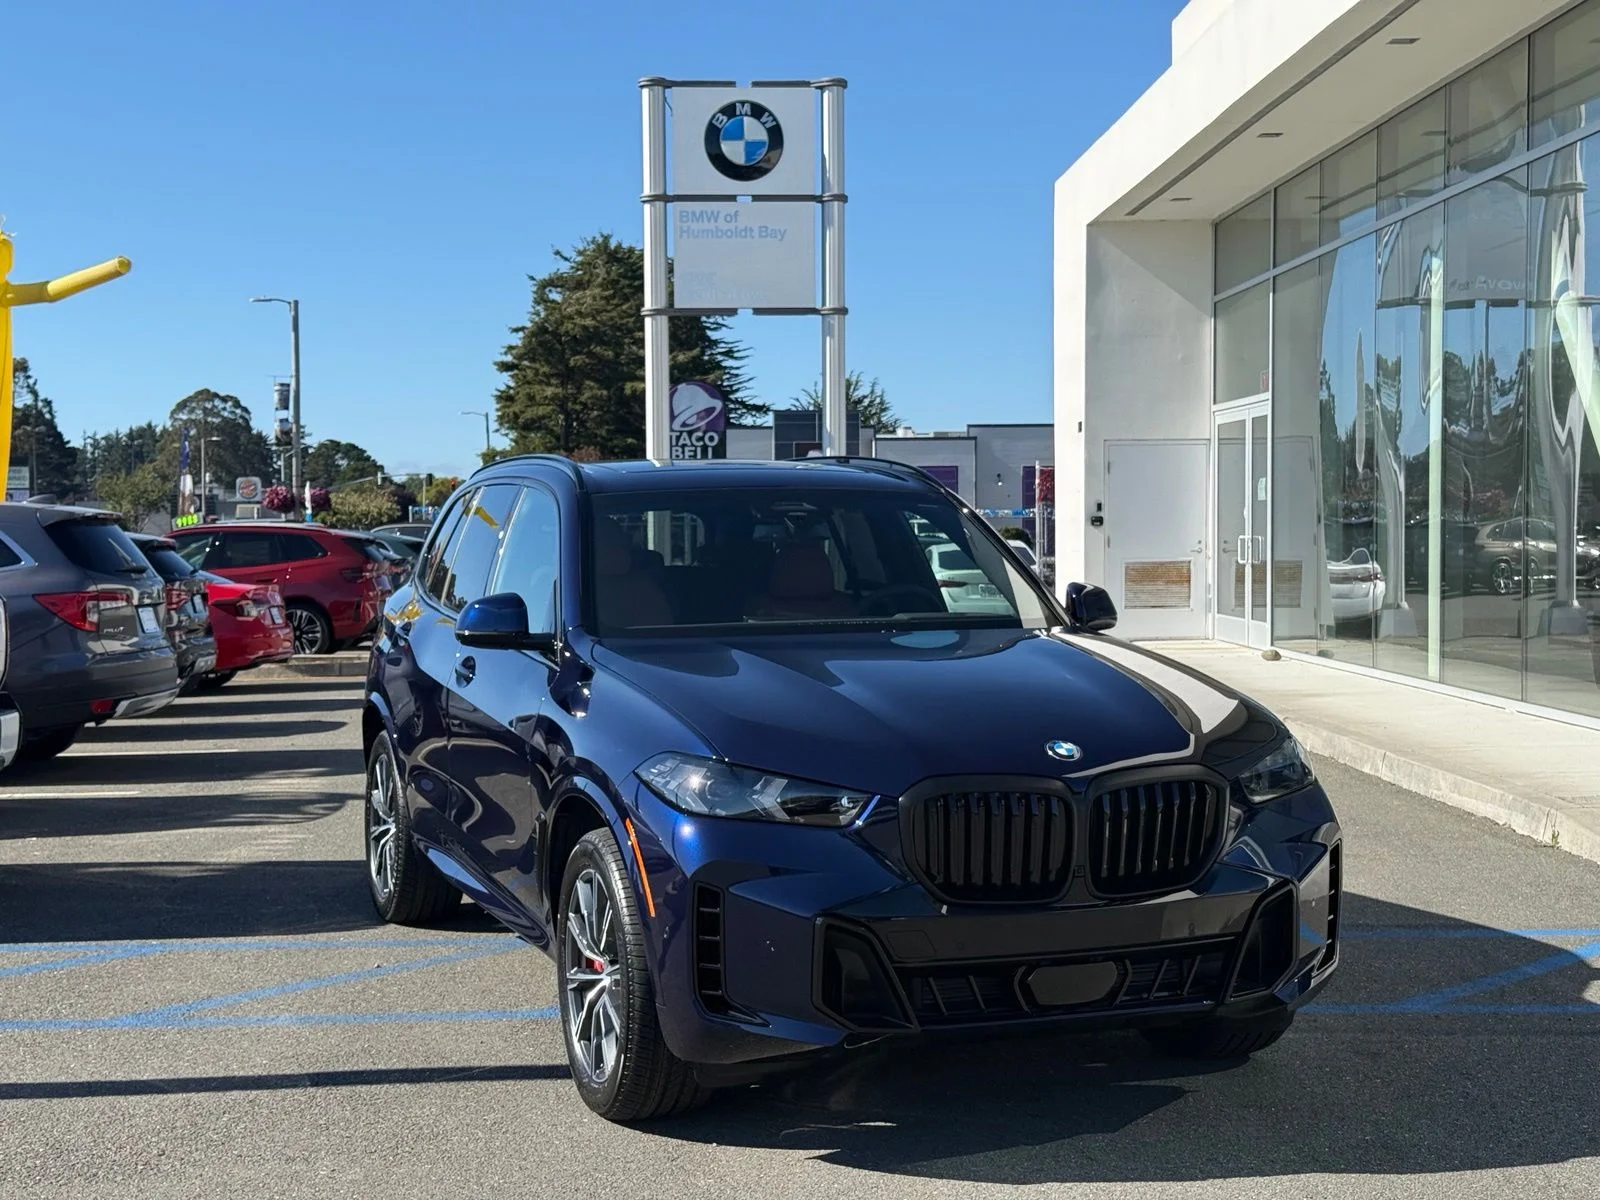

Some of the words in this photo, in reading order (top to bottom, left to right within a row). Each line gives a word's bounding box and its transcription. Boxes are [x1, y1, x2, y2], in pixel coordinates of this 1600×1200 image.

[712, 102, 776, 129] BMW
[679, 210, 720, 224] BMW
[723, 210, 740, 224] of
[679, 226, 755, 240] Humboldt
[757, 226, 787, 242] Bay
[669, 431, 719, 447] TACO
